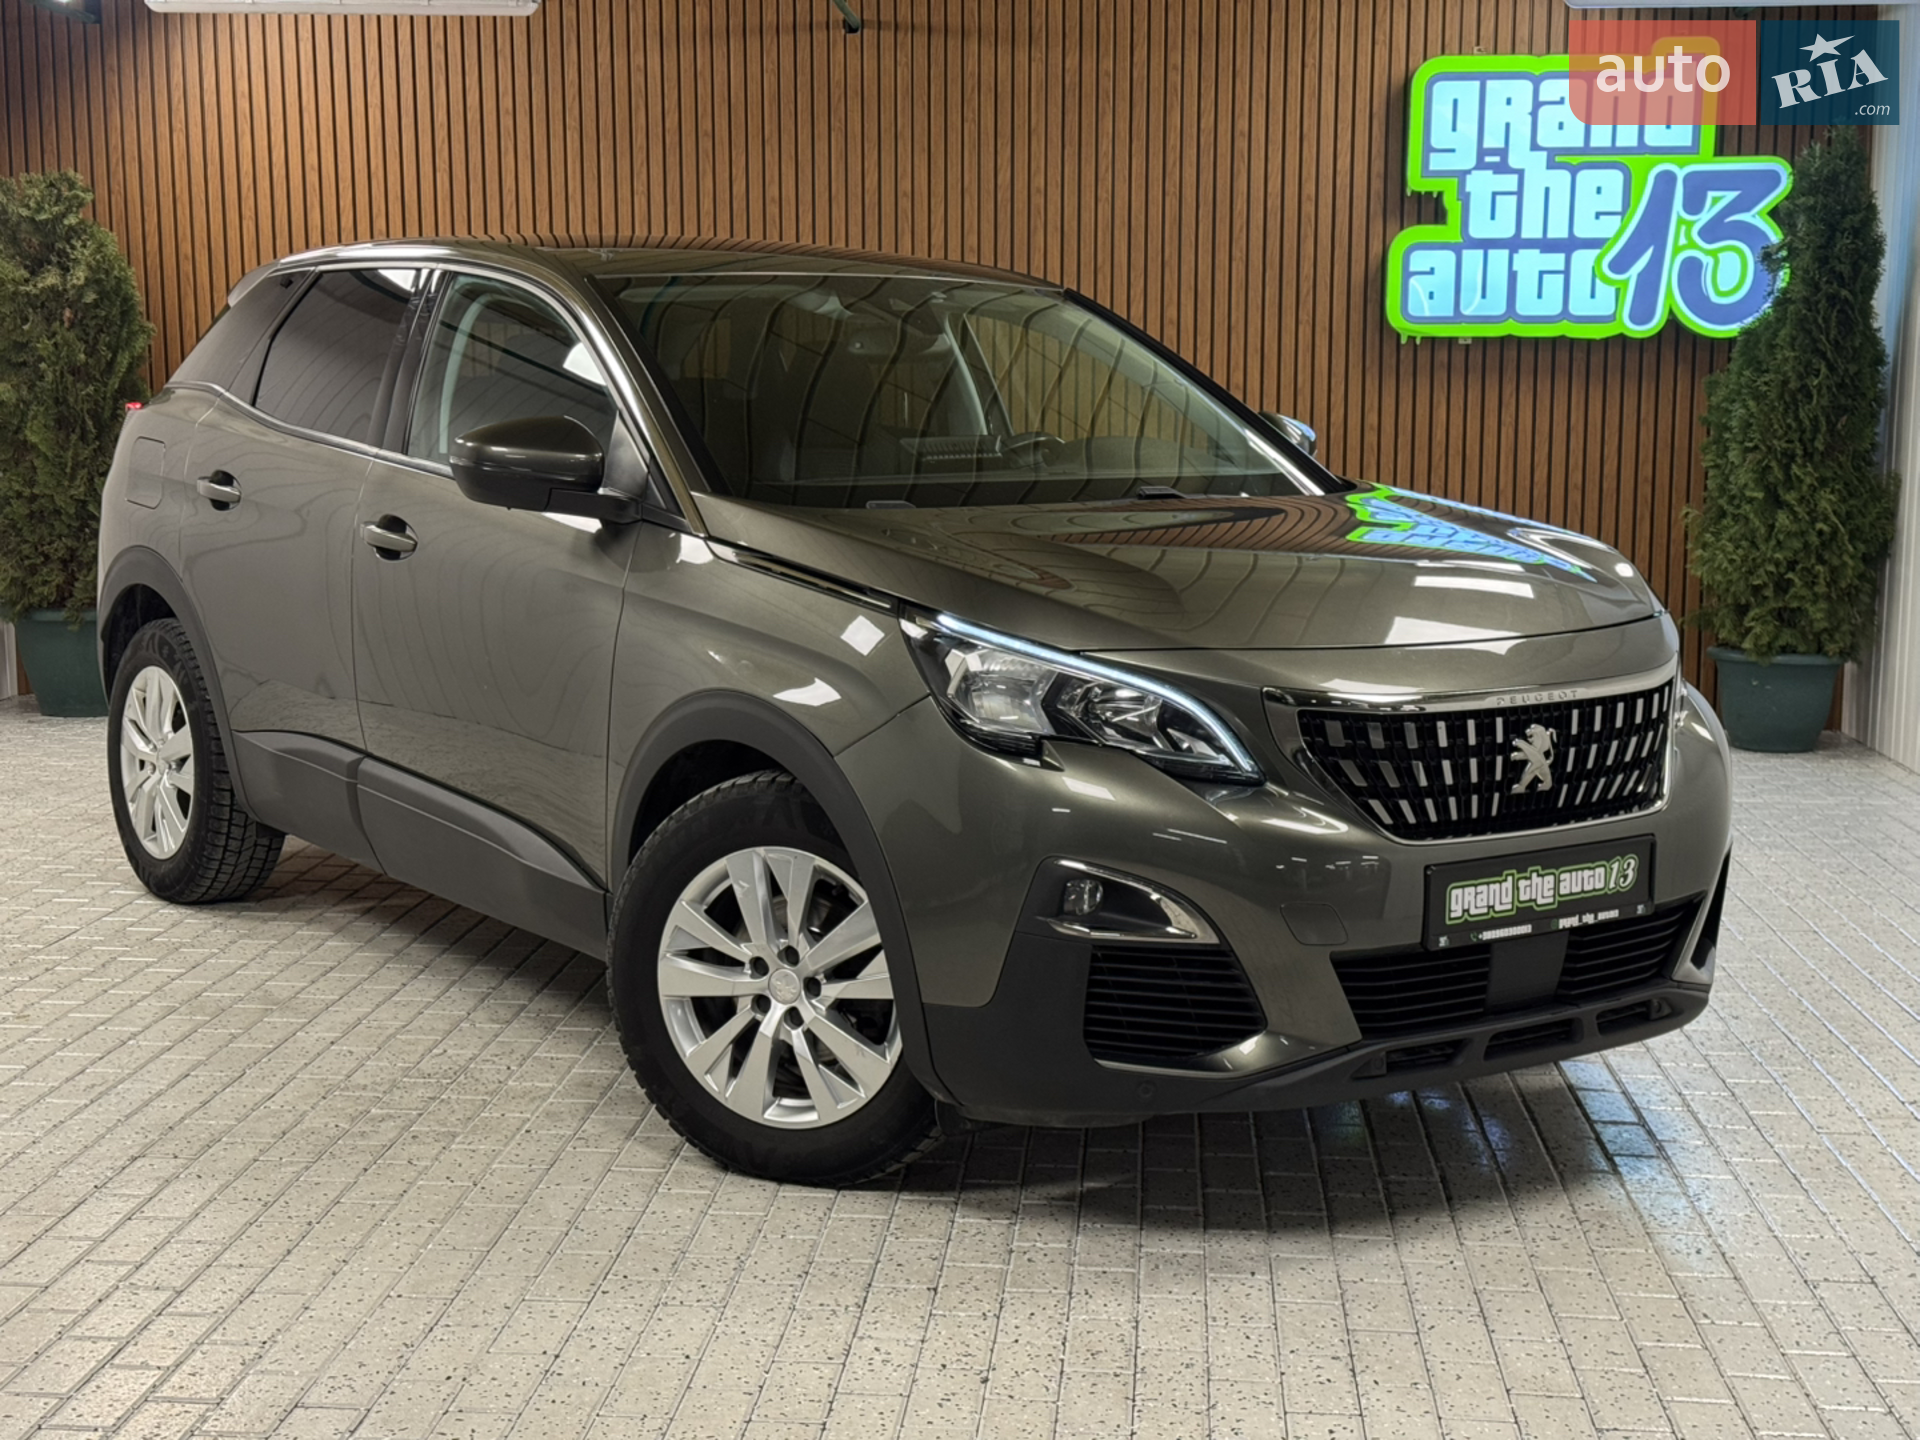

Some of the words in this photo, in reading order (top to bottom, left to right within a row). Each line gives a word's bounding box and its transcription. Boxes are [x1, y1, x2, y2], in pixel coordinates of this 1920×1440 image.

[1466, 153, 1624, 239] the
[1496, 690, 1578, 706] PEUGEOT
[1518, 872, 1555, 905] the
[1559, 866, 1606, 895] auto
[1608, 858, 1637, 890] 13
